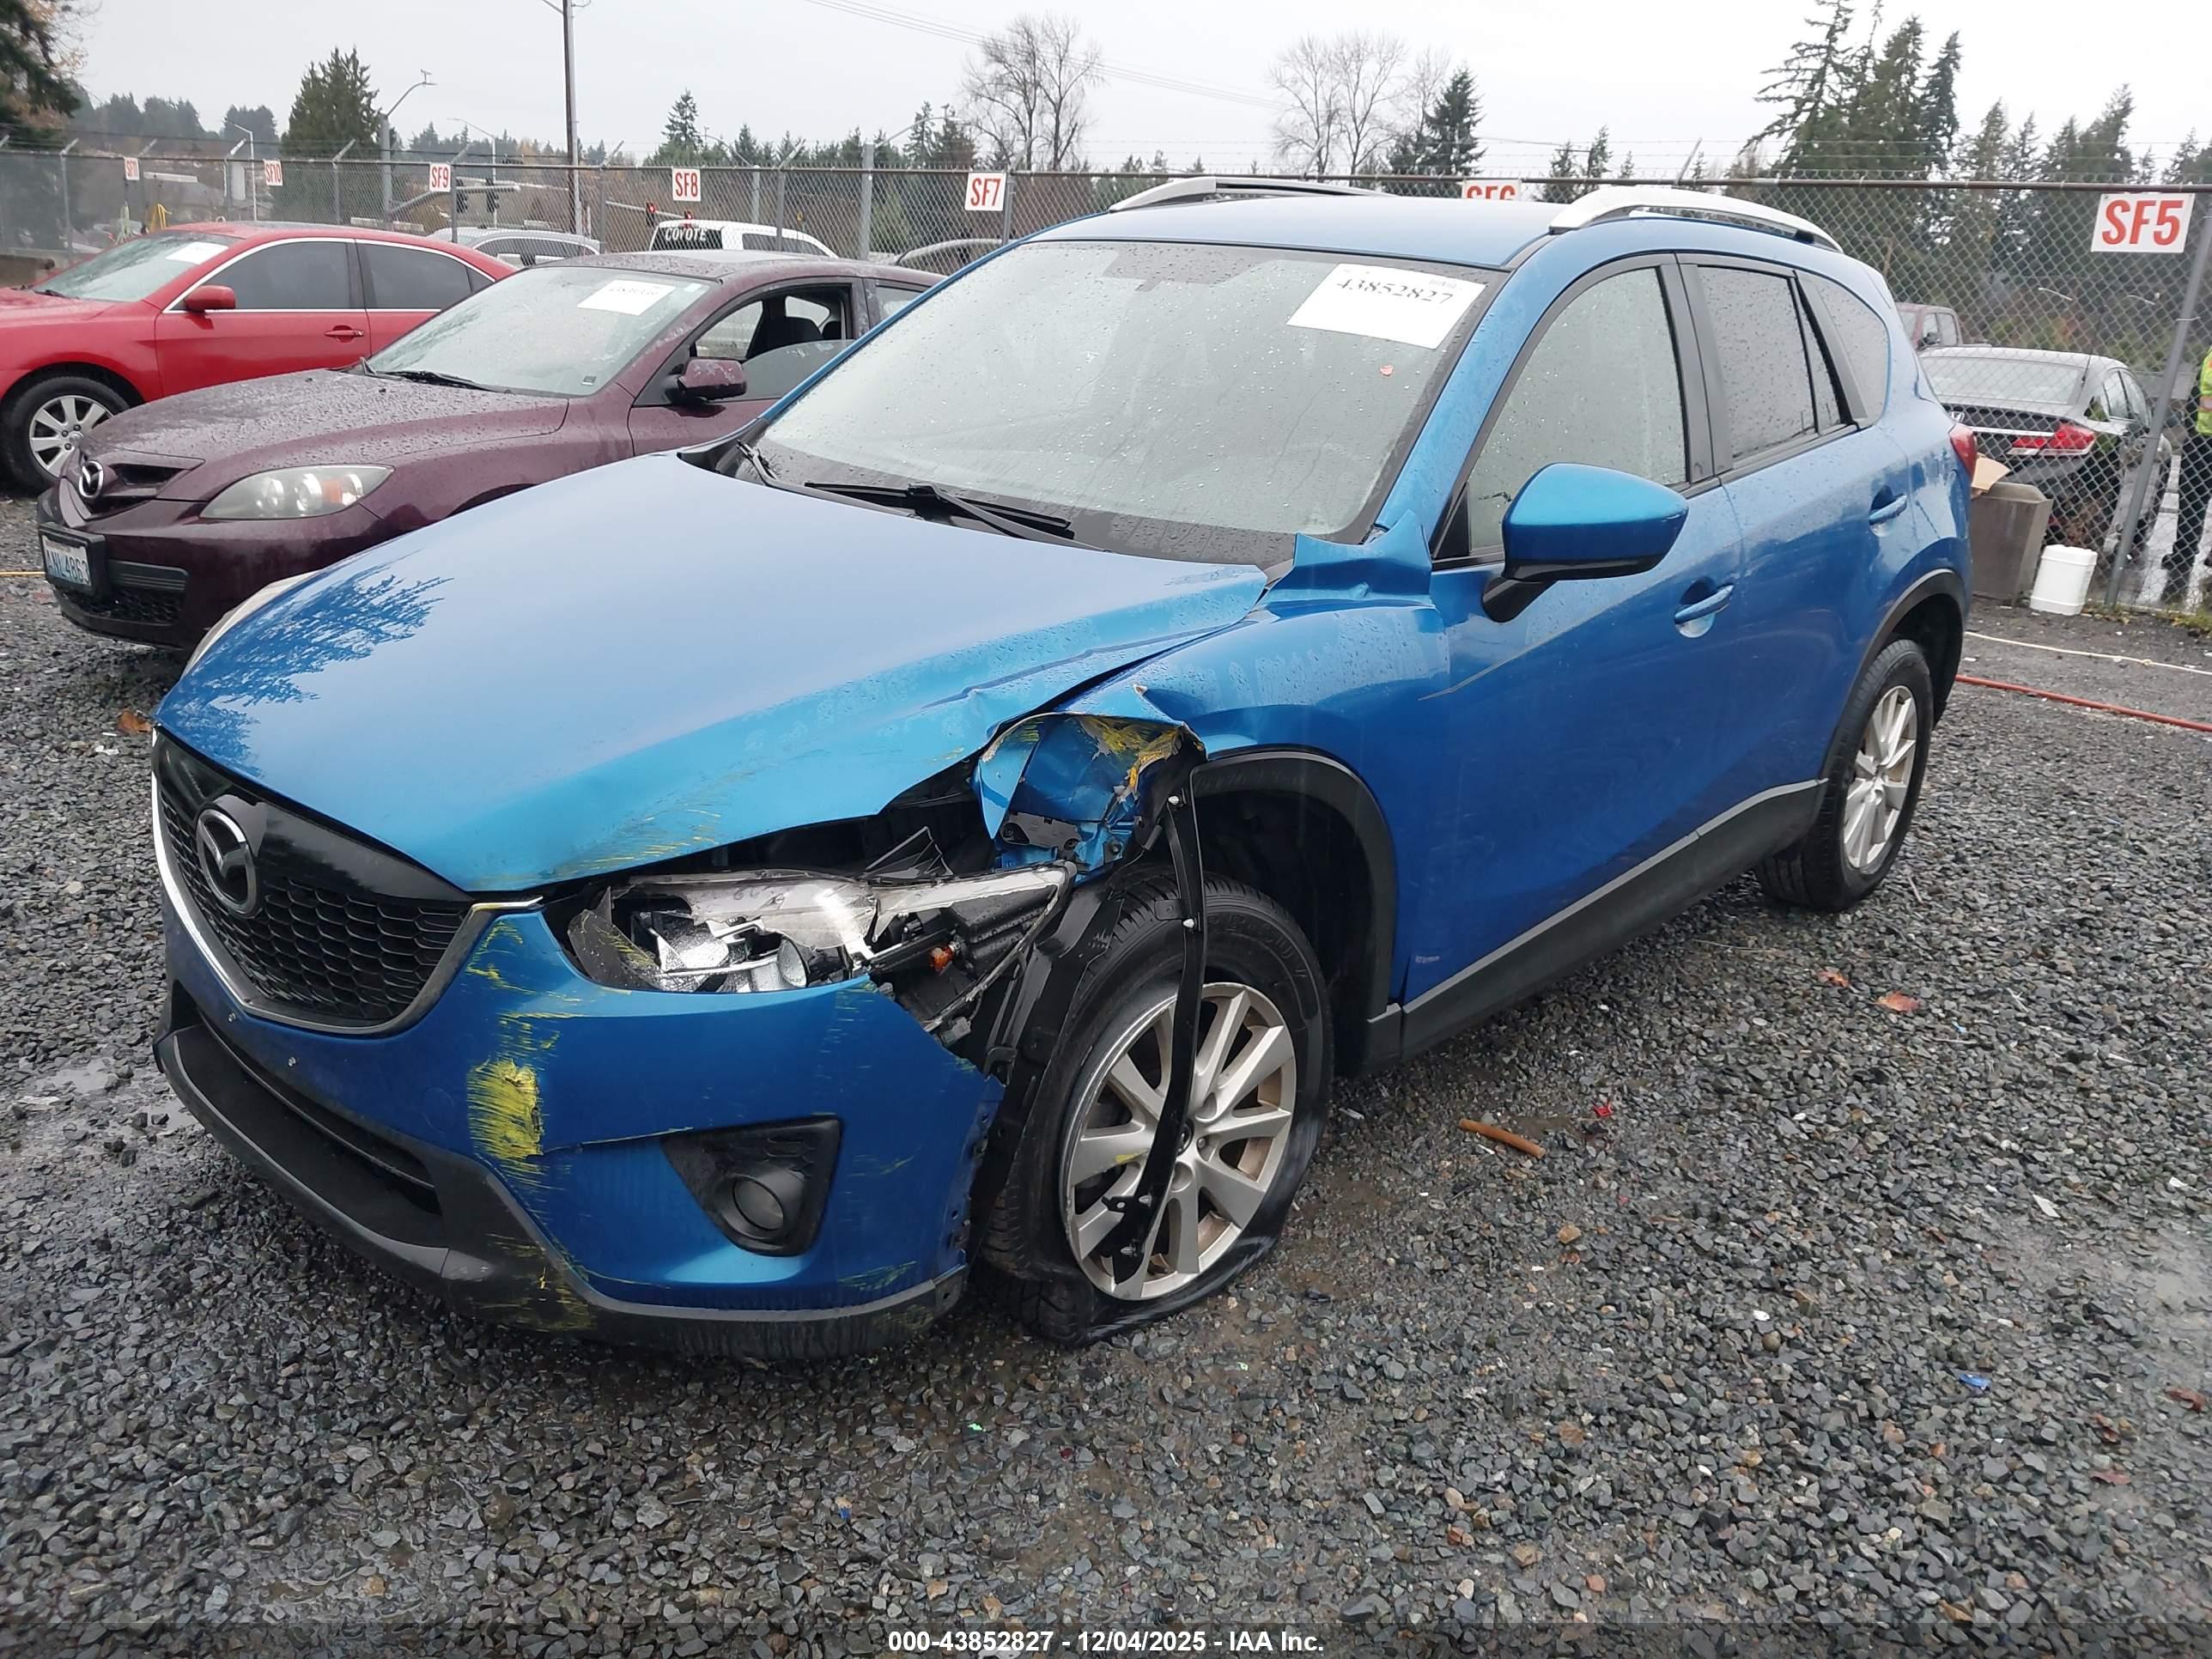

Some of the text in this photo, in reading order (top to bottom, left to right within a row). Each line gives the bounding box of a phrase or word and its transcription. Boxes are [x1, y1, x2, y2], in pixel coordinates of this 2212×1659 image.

[266, 164, 282, 183] SF10
[431, 166, 449, 188] SF9
[675, 173, 698, 198] SF8
[970, 178, 1001, 207] SF7
[665, 227, 707, 241] COYOTE
[2102, 199, 2185, 246] SF5
[1336, 278, 1454, 305] 43852827
